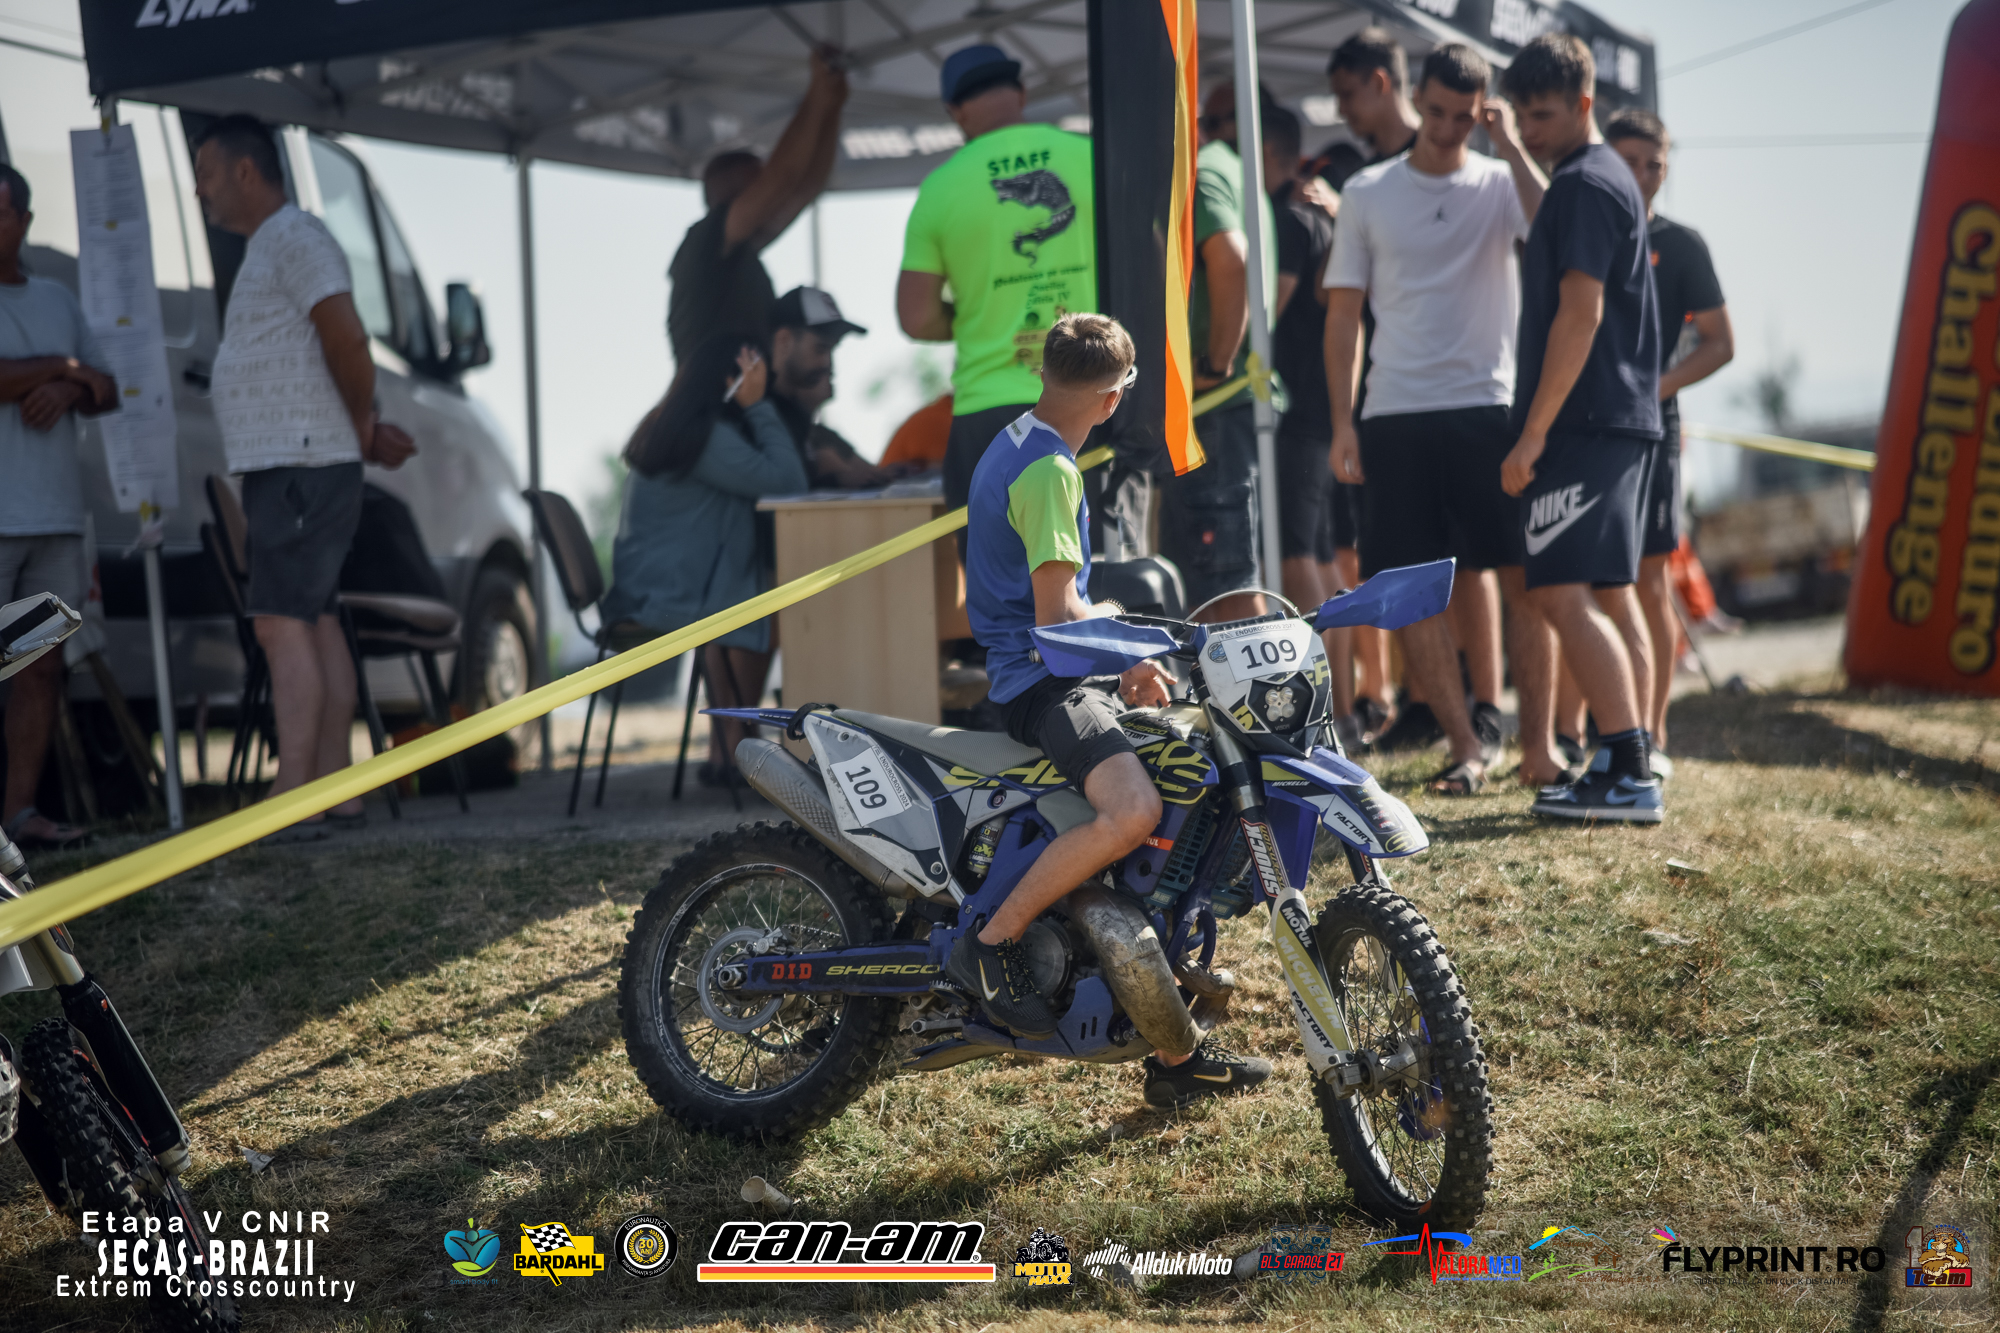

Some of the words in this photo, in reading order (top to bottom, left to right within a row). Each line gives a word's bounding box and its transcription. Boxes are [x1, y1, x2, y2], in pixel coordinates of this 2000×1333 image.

[988, 151, 1050, 177] STAFF
[1890, 206, 2000, 622] Challenge
[1529, 482, 1584, 531] NIKE
[1234, 623, 1281, 637] ENDUROCROSS
[1240, 639, 1297, 670] 109
[1122, 721, 1168, 735] SHERCO
[845, 766, 887, 809] 109
[880, 756, 902, 794] ENDUROCROSS
[900, 793, 910, 807] 2024
[1144, 837, 1159, 847] TUL
[1333, 811, 1373, 844] FACTORY
[1243, 823, 1280, 895] SHOCK
[1282, 906, 1313, 949] MOTUL
[826, 964, 940, 975] SHERCO
[1277, 935, 1343, 1030] MICHELIN
[1291, 990, 1334, 1050] FACTORY
